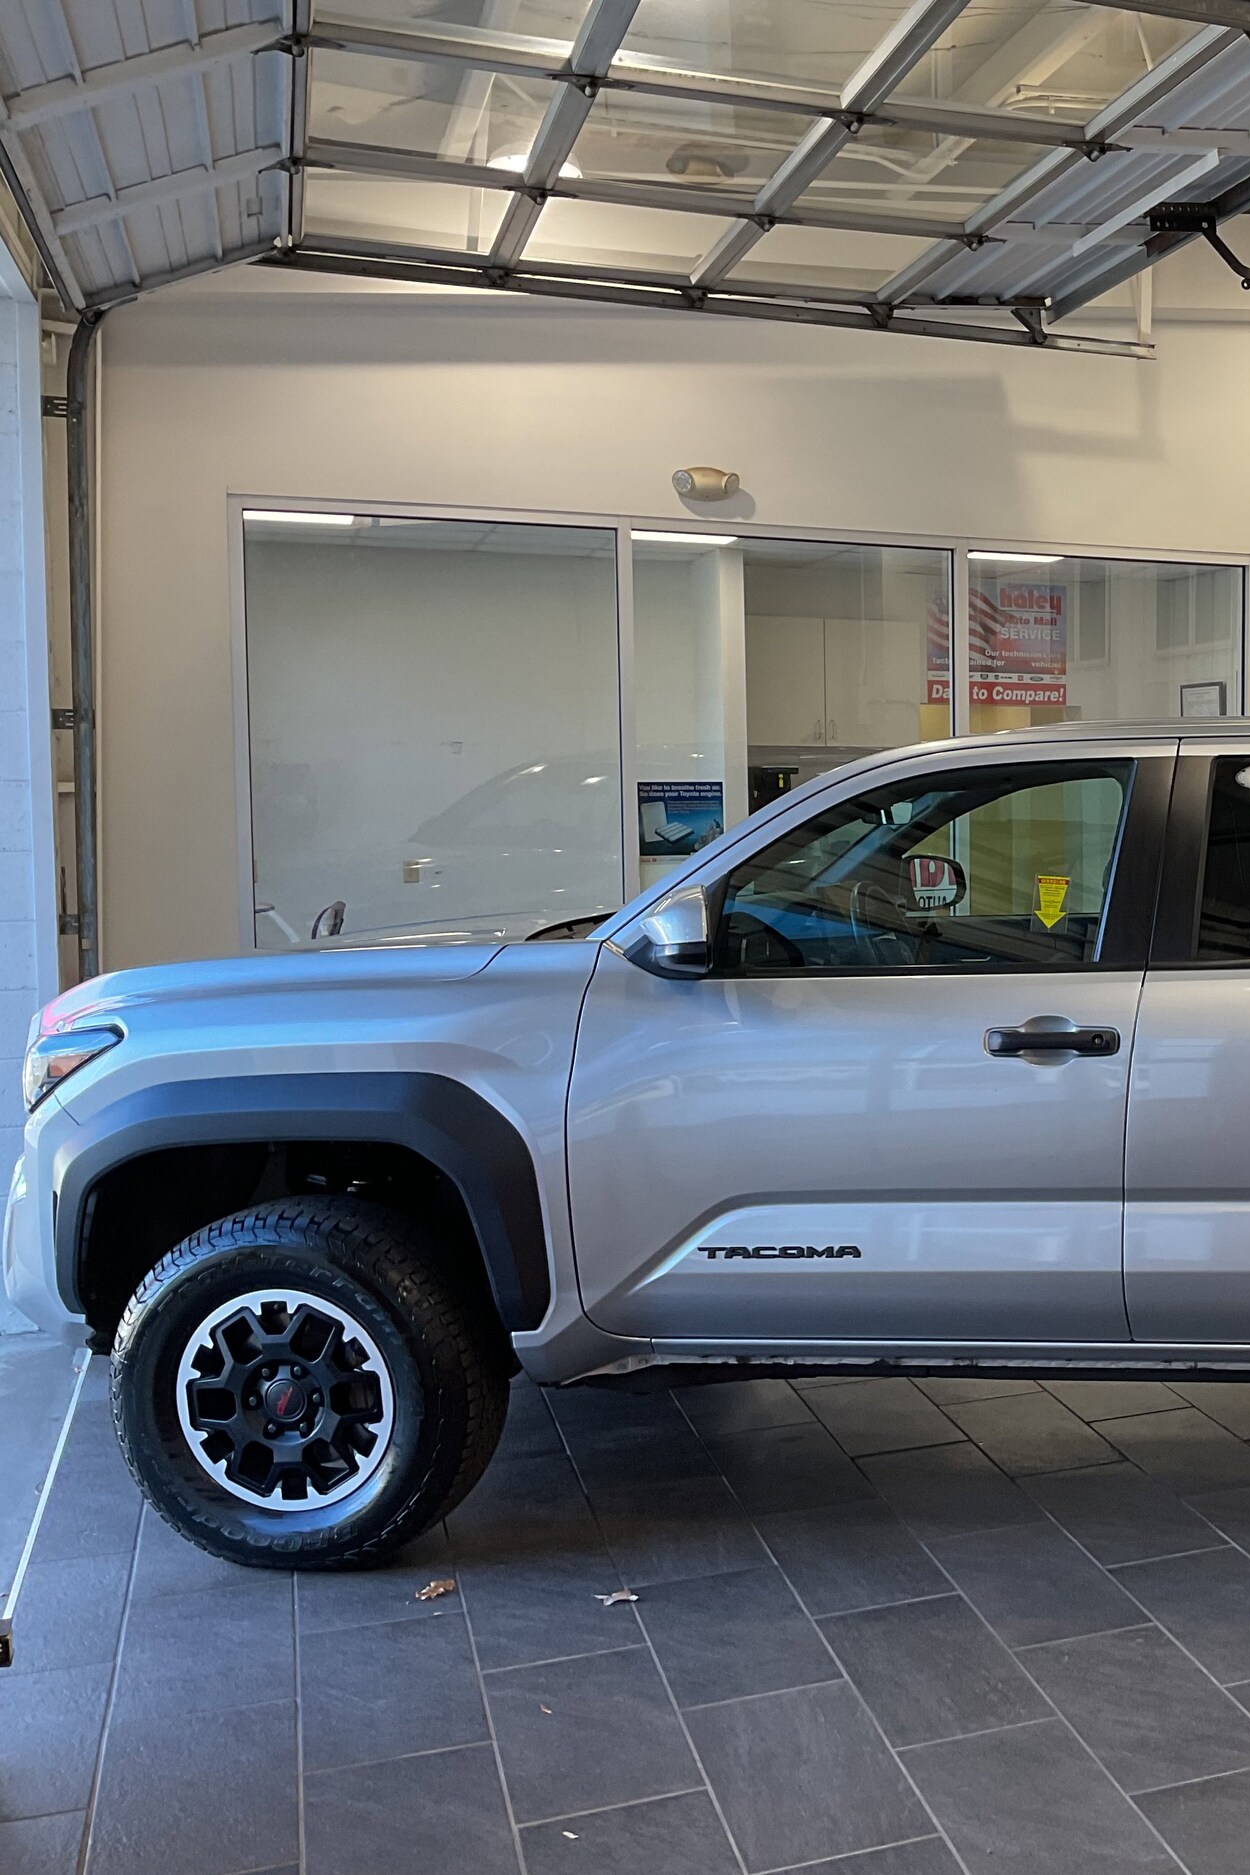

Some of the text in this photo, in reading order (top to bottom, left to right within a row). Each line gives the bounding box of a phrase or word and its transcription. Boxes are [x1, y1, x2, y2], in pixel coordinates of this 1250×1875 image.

[1000, 588, 1062, 615] haley
[1034, 616, 1057, 626] Mall
[1001, 627, 1061, 640] SERVICE
[985, 649, 1000, 657] Our
[972, 686, 988, 700] to
[992, 686, 1064, 703] Compare!
[697, 1246, 862, 1259] TACOMA
